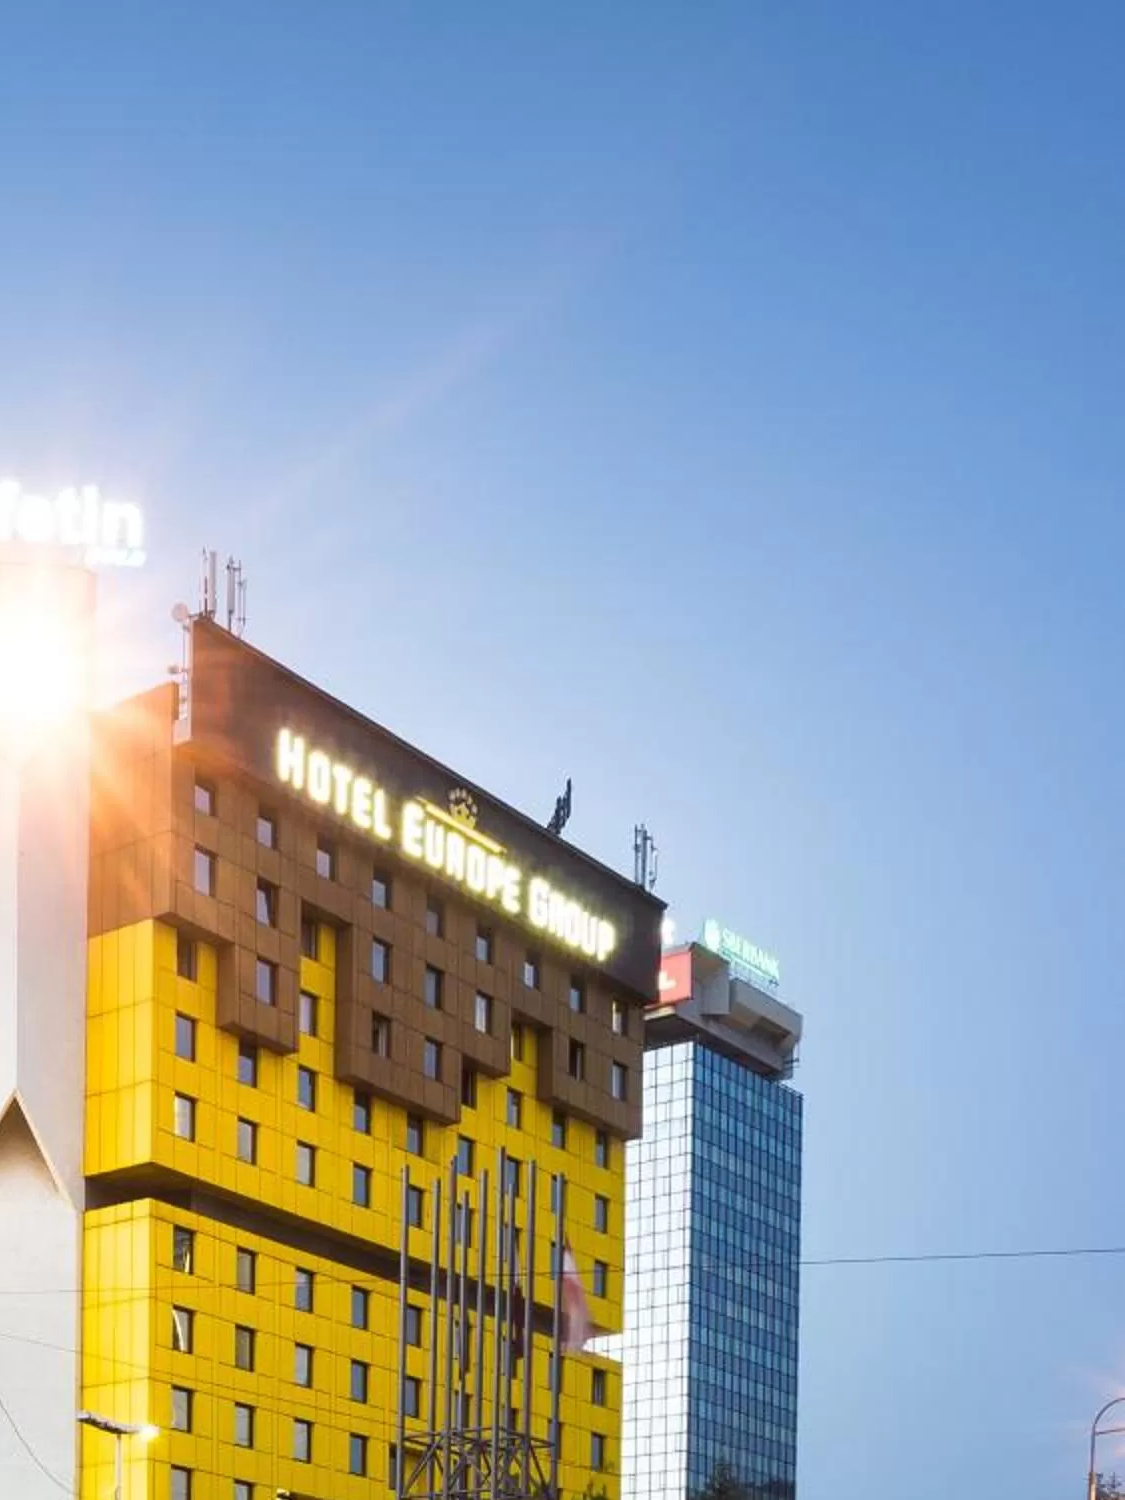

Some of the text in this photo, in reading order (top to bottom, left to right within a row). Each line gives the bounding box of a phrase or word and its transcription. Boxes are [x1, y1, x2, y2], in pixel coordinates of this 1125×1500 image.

[276, 727, 617, 963] HOTEL EUROPE GROUP
